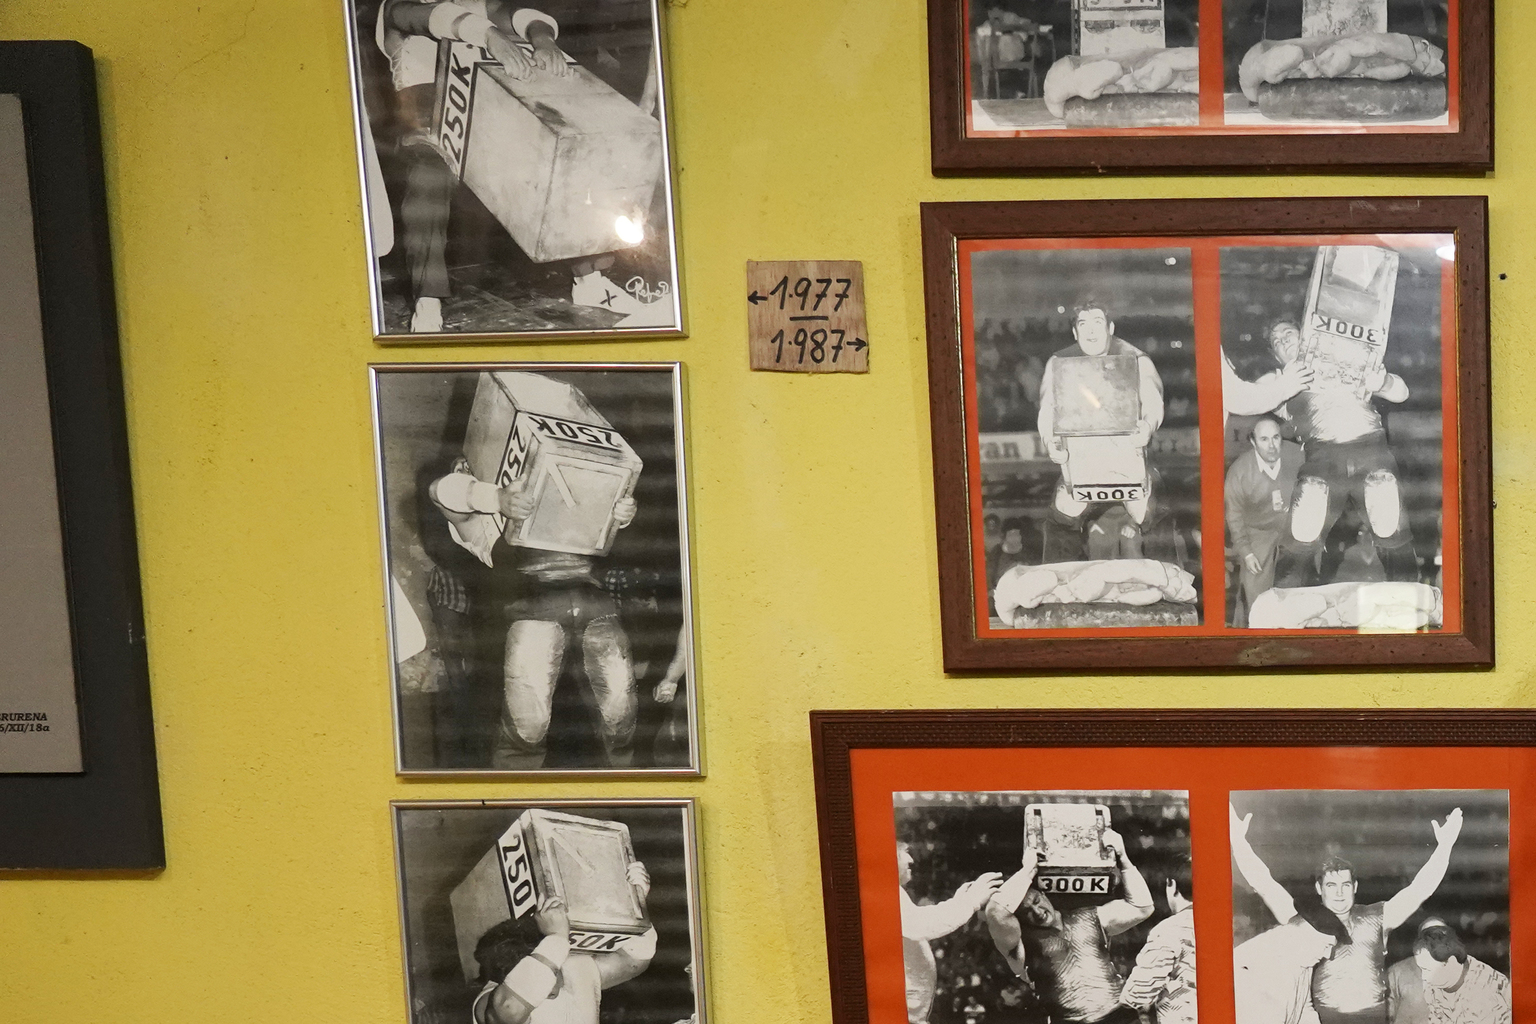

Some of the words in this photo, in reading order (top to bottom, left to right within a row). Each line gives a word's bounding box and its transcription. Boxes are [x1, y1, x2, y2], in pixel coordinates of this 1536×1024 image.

[442, 52, 471, 164] 250K
[770, 275, 852, 312] 1.977
[1316, 316, 1379, 342] 300K
[770, 328, 846, 364] 1.987
[528, 415, 622, 448] 250K
[501, 424, 527, 489] 250
[1077, 489, 1138, 500] 300K
[0, 713, 47, 721] RURENA
[502, 834, 536, 915] 250
[1041, 878, 1105, 892] 300K
[569, 933, 631, 949] 50K
